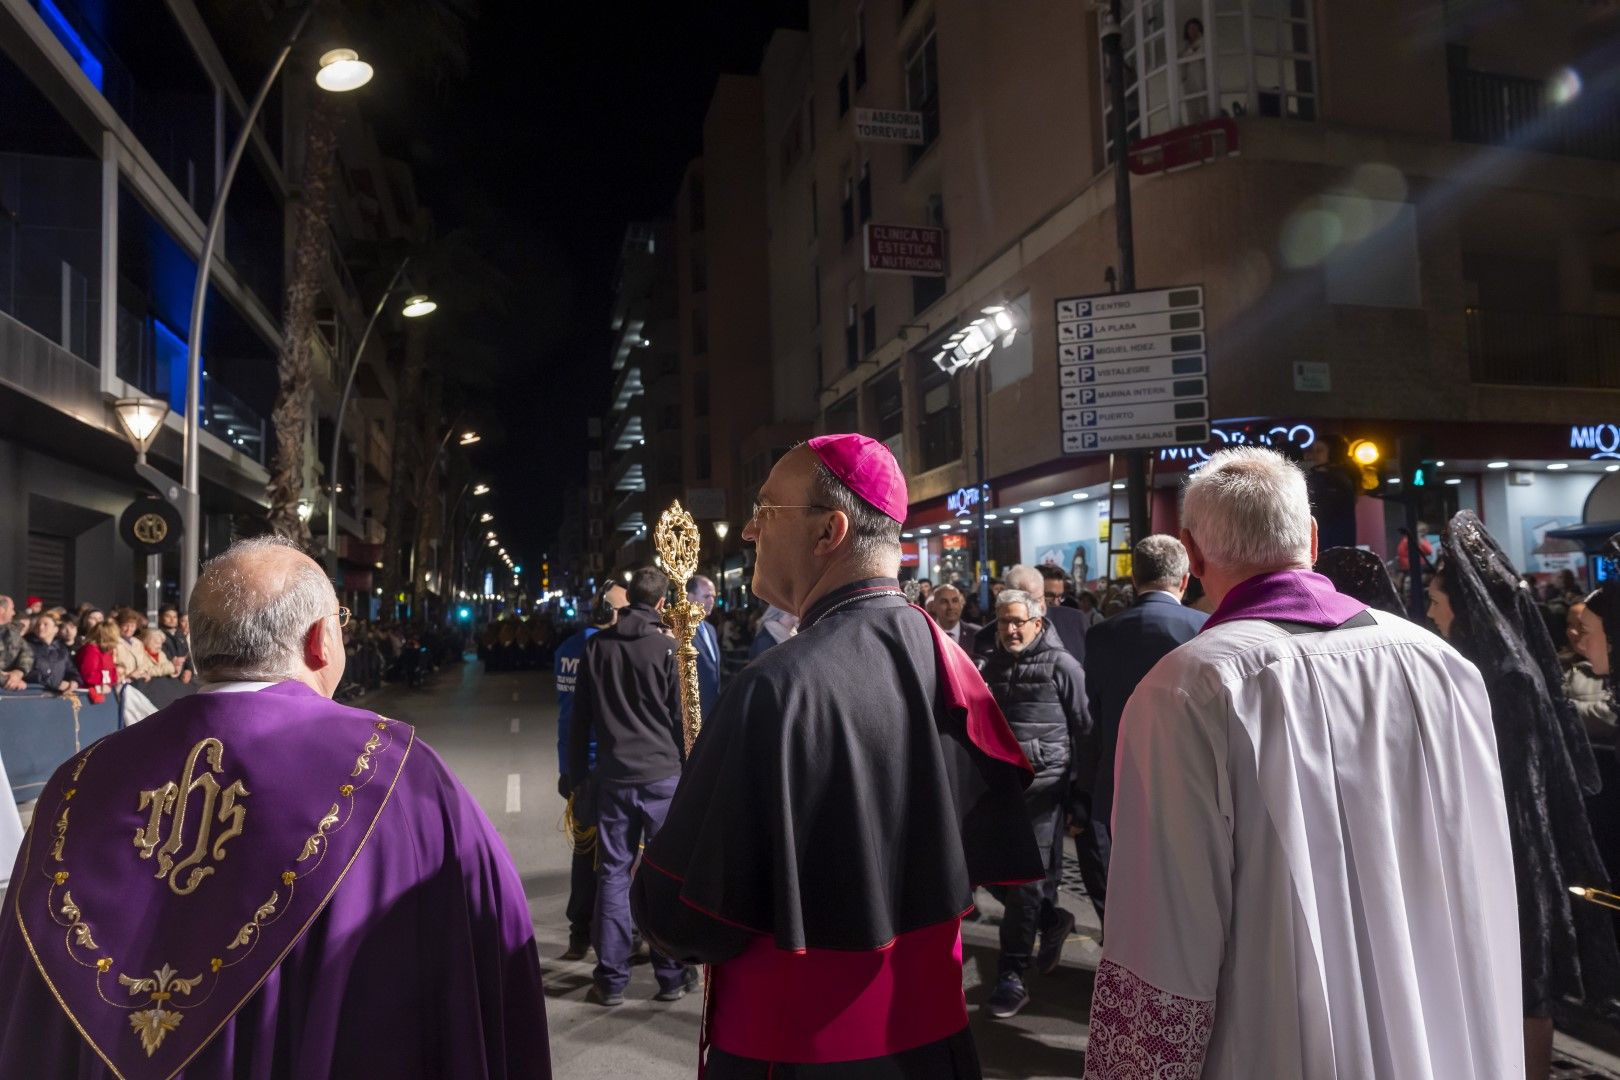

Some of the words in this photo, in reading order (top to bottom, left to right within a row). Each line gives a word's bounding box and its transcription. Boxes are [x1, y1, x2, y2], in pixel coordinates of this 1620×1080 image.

[872, 111, 920, 125] ASESORIA
[858, 124, 921, 140] TORREVIEJA
[922, 230, 937, 243] DE
[871, 255, 879, 266] Y
[1077, 302, 1090, 317] P
[1095, 300, 1131, 311] CENTRO
[1078, 324, 1091, 339] P
[1095, 324, 1106, 334] LA
[1079, 346, 1092, 360] P
[1096, 345, 1128, 355] MIGUEL
[1081, 368, 1093, 382] P
[1097, 365, 1151, 377] VISTALEGRE
[1082, 390, 1094, 404] P
[1098, 389, 1131, 399] MARINA
[1083, 412, 1095, 426] P
[1099, 412, 1134, 420] PUERTO
[1083, 433, 1096, 448] P
[1100, 433, 1134, 443] MARINA
[1136, 431, 1173, 441] SALINAS
[1570, 424, 1620, 453] MIO
